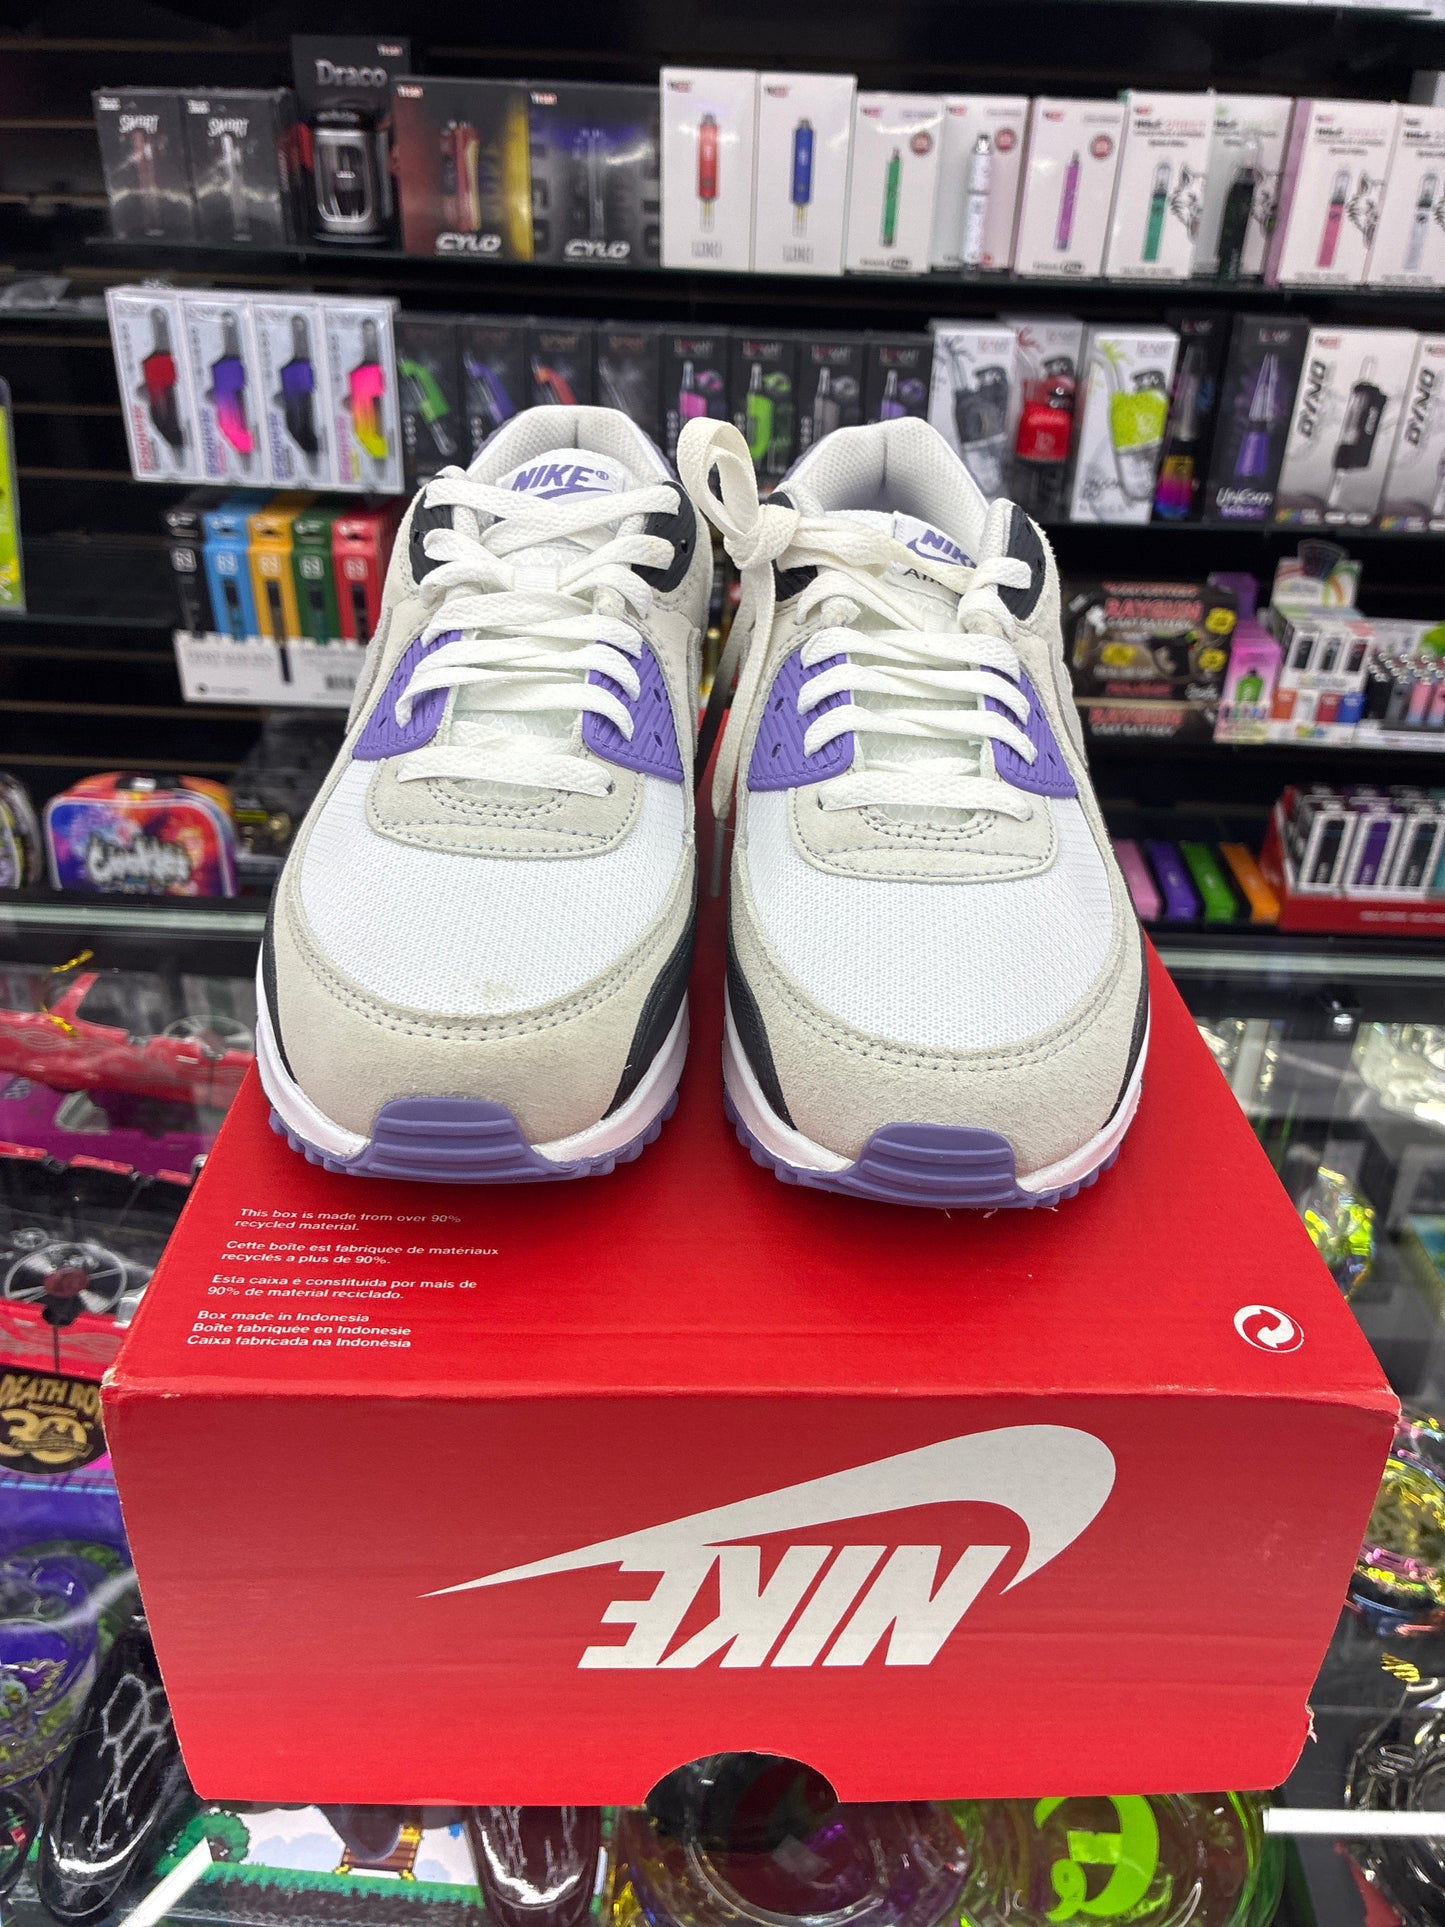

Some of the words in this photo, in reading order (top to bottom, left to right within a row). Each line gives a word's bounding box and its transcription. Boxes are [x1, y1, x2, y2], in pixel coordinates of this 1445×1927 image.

[315, 59, 387, 87] Draco
[920, 529, 978, 569] NIK
[241, 1209, 268, 1217] This
[272, 1210, 297, 1218] box
[318, 1212, 356, 1220] made
[361, 1213, 392, 1221] from
[432, 1214, 461, 1223] 90%
[235, 1220, 295, 1229] recycled
[299, 1221, 359, 1231] material.
[226, 1241, 265, 1250] Cette
[335, 1244, 402, 1254] fabriquée
[407, 1246, 424, 1254] de
[429, 1247, 498, 1255] matériaux
[298, 1254, 329, 1264] plus
[333, 1255, 351, 1263] de
[355, 1255, 391, 1264] 90%.
[212, 1275, 245, 1284] Esta
[249, 1276, 288, 1285] caixa
[390, 1279, 416, 1289] por
[420, 1280, 455, 1289] mais
[459, 1280, 477, 1289] de
[208, 1286, 240, 1296] 90%
[245, 1287, 263, 1296] de
[267, 1288, 328, 1297] material
[332, 1289, 404, 1299] reciclado.
[197, 1310, 226, 1320] Box
[231, 1312, 273, 1321] made
[278, 1312, 292, 1321] in
[296, 1312, 369, 1322] Indonesia
[237, 1323, 309, 1335] fabriquée
[314, 1326, 332, 1334] en
[187, 1335, 231, 1345] Caixa
[235, 1336, 309, 1346] fabricada
[312, 1338, 331, 1346] na
[336, 1338, 411, 1348] Indonésia
[69, 1382, 103, 1423] RO
[577, 1546, 1011, 1669] NIKE
